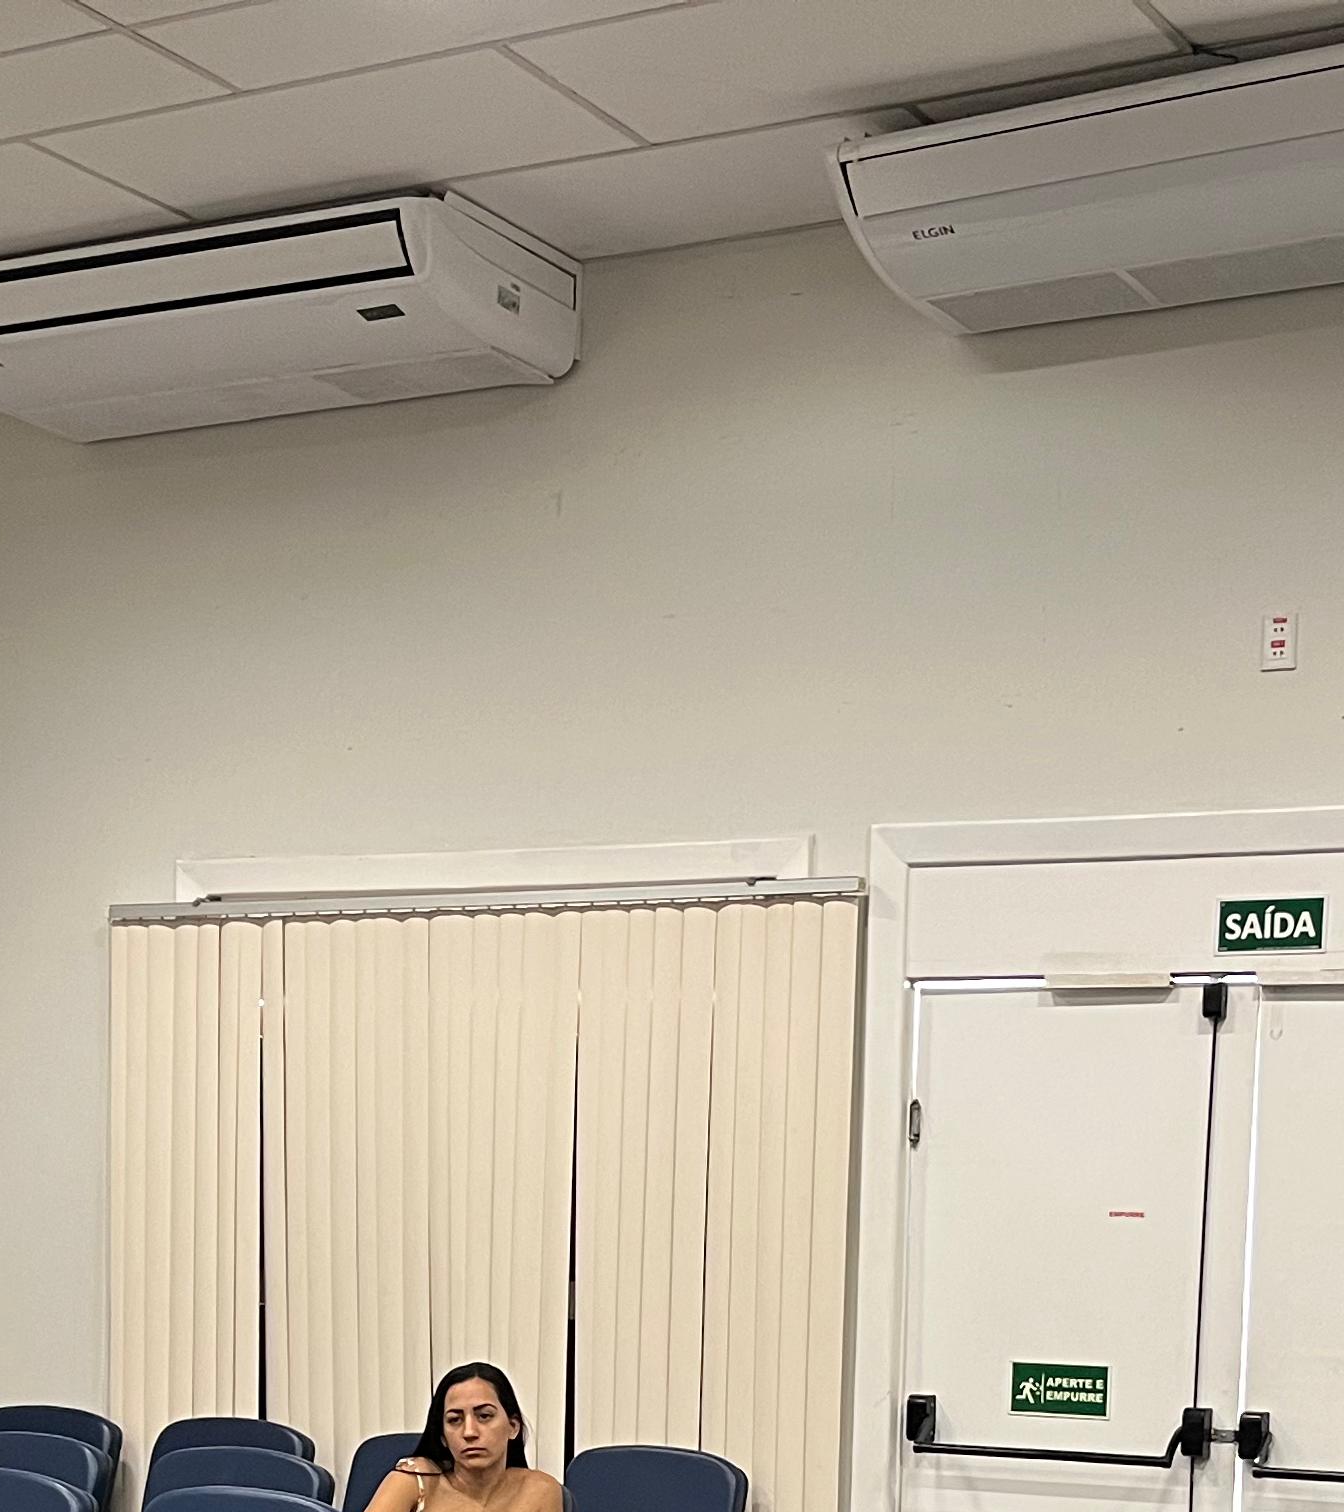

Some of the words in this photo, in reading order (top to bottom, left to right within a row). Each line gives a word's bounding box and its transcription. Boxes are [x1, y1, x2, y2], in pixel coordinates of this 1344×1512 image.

[912, 224, 955, 240] ELGIN
[1224, 905, 1316, 940] SAÍDA
[1046, 1377, 1093, 1389] APERTE
[1095, 1379, 1104, 1390] E
[1045, 1391, 1104, 1403] EMPURRE
